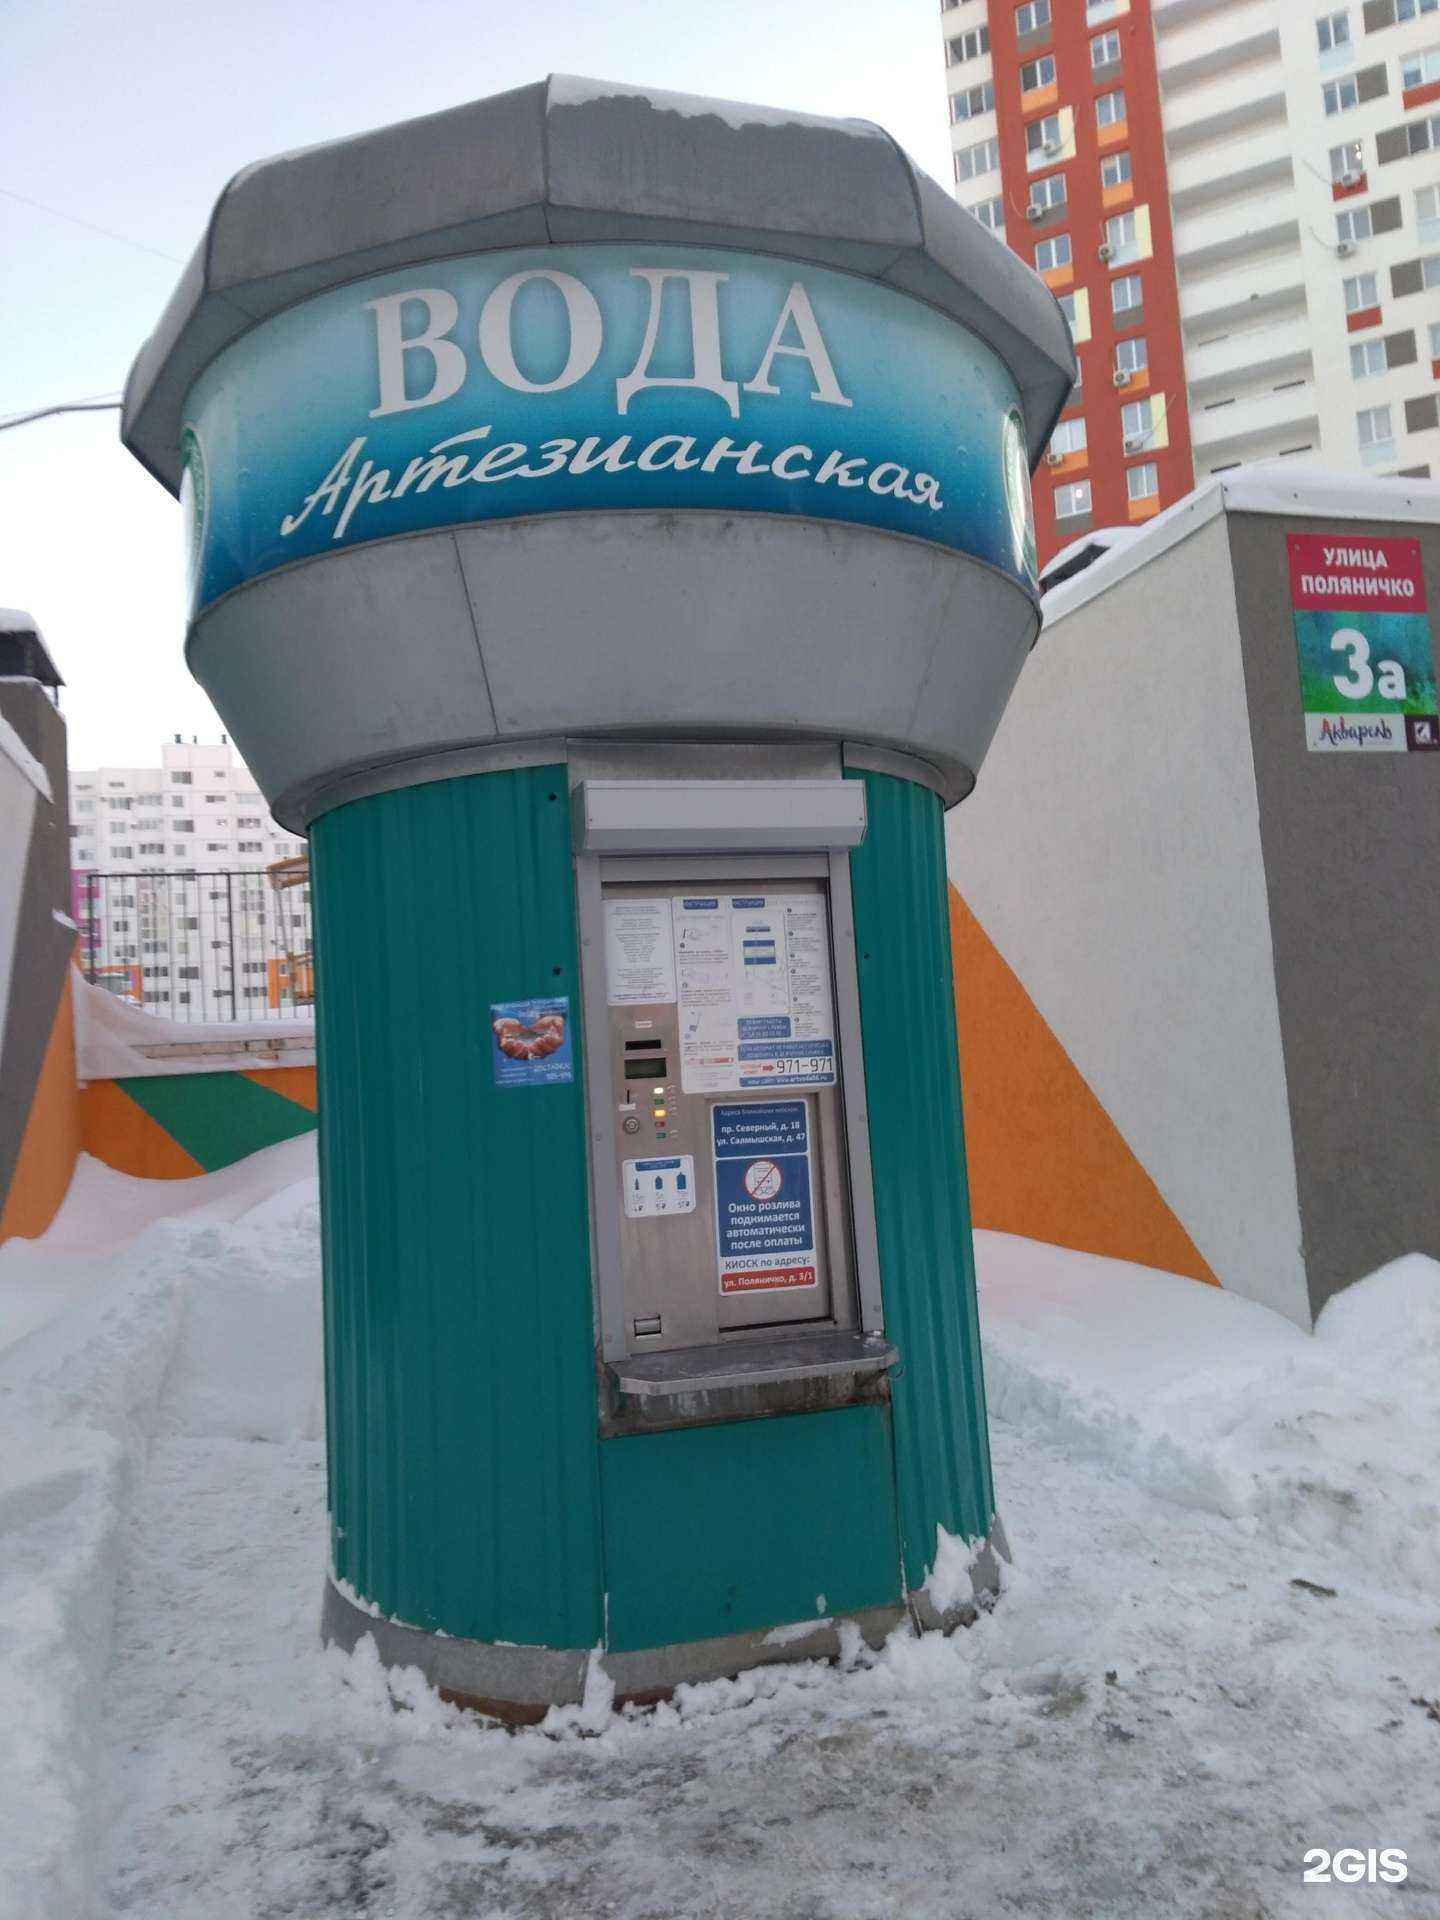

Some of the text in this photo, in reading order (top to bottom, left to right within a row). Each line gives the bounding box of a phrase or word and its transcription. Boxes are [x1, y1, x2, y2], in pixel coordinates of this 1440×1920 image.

[364, 267, 854, 419] ВОДА
[281, 425, 945, 539] Артезианская
[1323, 547, 1388, 571] УЛИЦА
[1301, 574, 1415, 597] ПОЛЯНИЧКО
[1330, 628, 1407, 700] 3а
[1319, 715, 1392, 747] Акварель
[776, 1057, 833, 1074] 971-971
[721, 1125, 734, 1134] пр.
[735, 1121, 779, 1133] Северный,
[781, 1123, 789, 1131] д.
[716, 1132, 806, 1147] ул. Салмышская, д. 47
[728, 1200, 801, 1213] Окно розлива
[731, 1212, 800, 1226] поднимается
[726, 1224, 805, 1238] автоматически
[731, 1237, 802, 1250] после оплаты
[725, 1255, 810, 1270] КИОСК по адресу:
[724, 1278, 737, 1289] ул.
[738, 1275, 787, 1287] Поляничко,
[788, 1274, 797, 1284] д.
